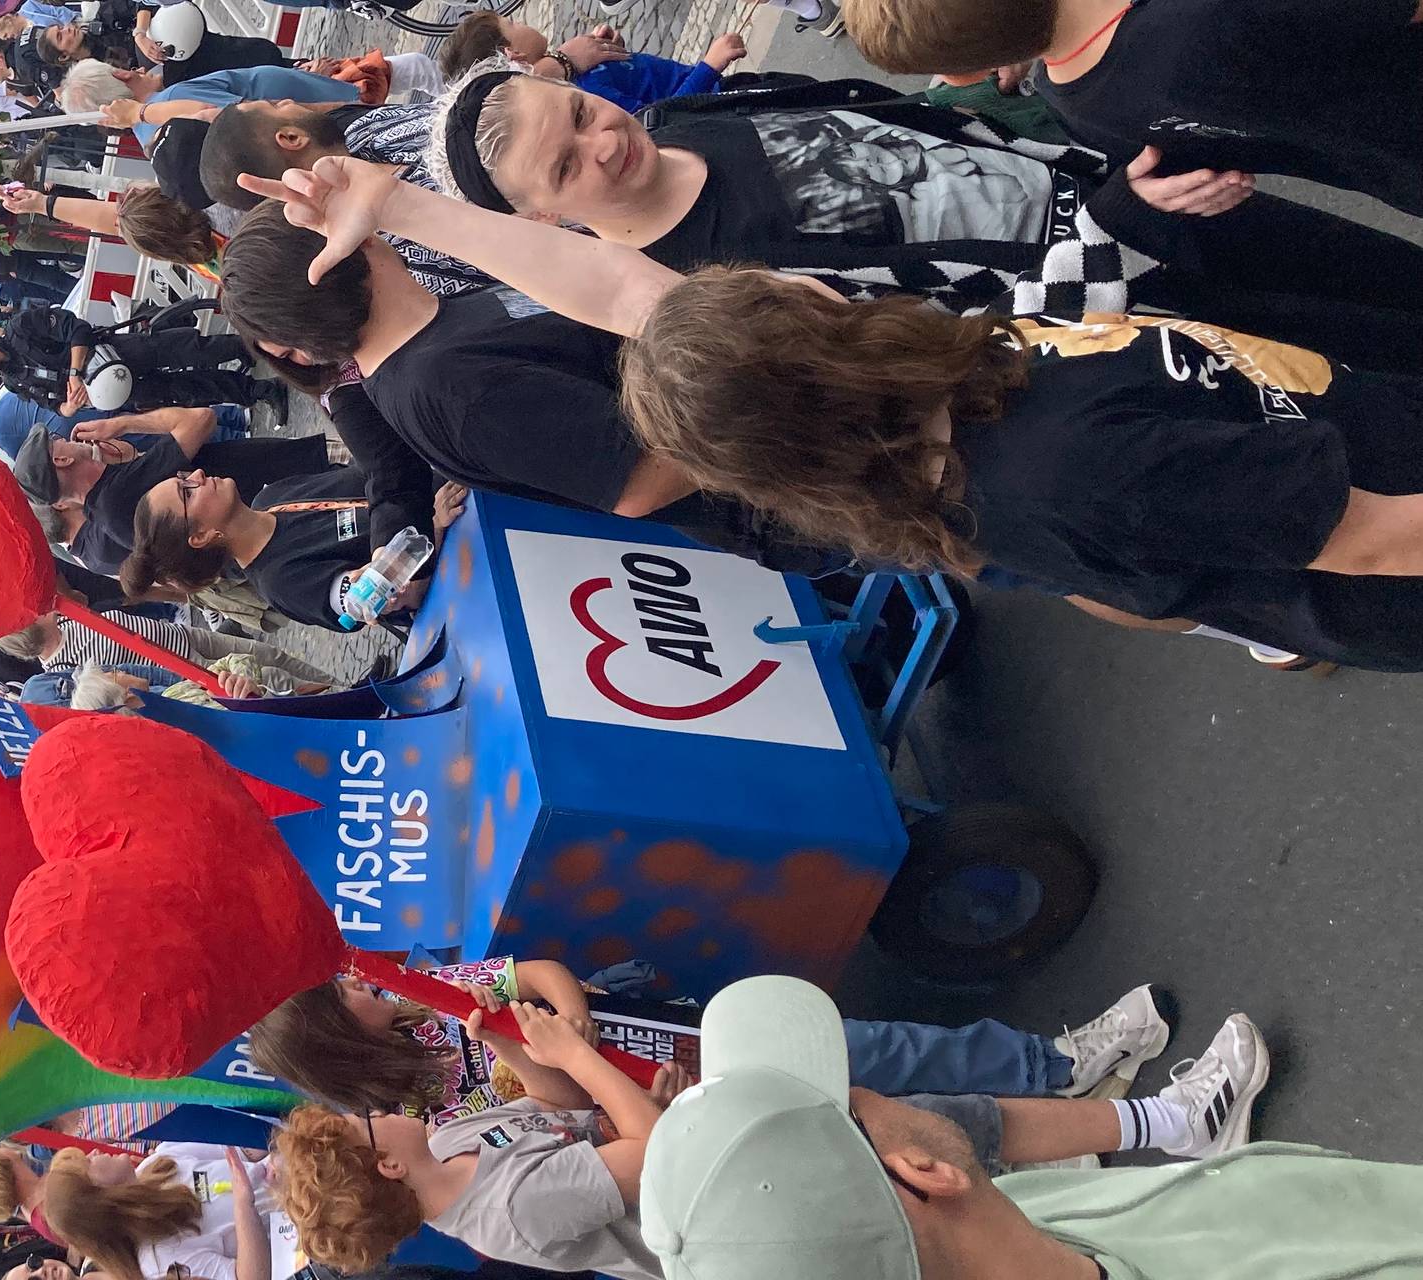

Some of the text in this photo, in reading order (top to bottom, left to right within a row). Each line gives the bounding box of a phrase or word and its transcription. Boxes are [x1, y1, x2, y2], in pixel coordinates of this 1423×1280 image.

[620, 552, 723, 678] AWO
[334, 730, 386, 931] FASCHIS-
[388, 789, 429, 882] MUS
[467, 1041, 486, 1080] sichtb
